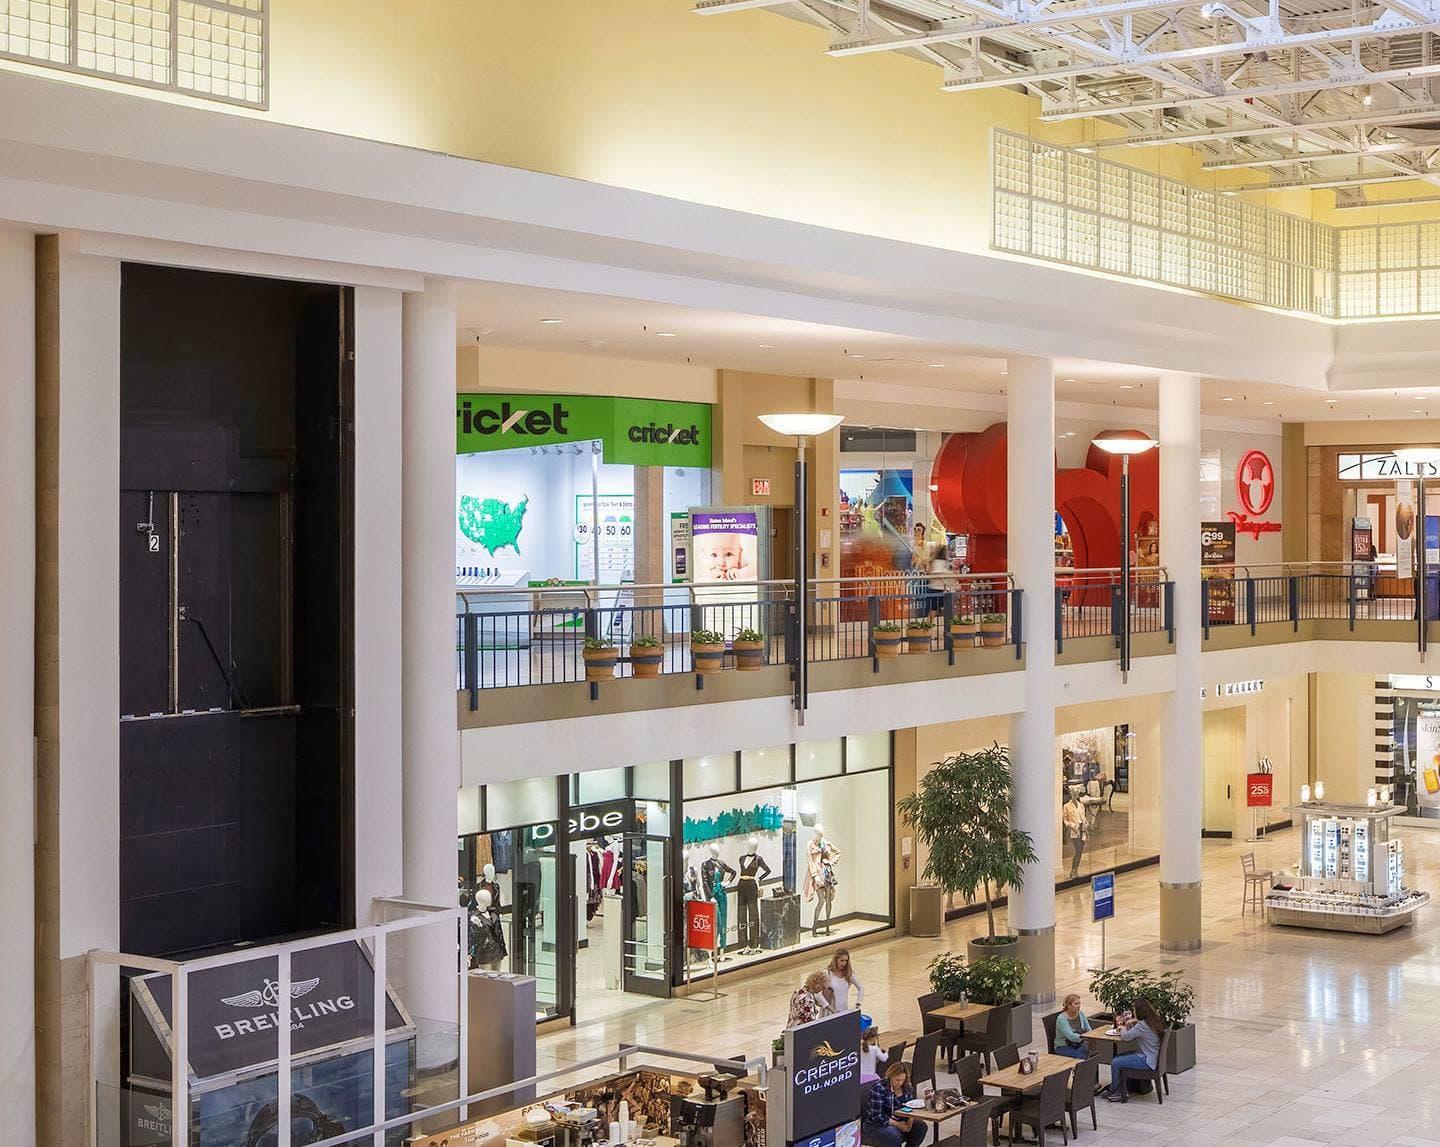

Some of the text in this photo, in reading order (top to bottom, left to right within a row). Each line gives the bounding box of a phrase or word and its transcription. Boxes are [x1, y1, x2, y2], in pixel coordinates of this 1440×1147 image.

[456, 402, 569, 435] icket
[628, 423, 700, 446] cricket
[606, 525, 616, 536] 50
[620, 525, 631, 536] 60
[151, 536, 158, 549] 2
[1227, 681, 1264, 694] MARKET
[214, 995, 355, 1040] BREILING
[794, 1051, 859, 1085] CRÊPES
[804, 1070, 853, 1095] DU NORD
[137, 1118, 172, 1134] BREITLI
